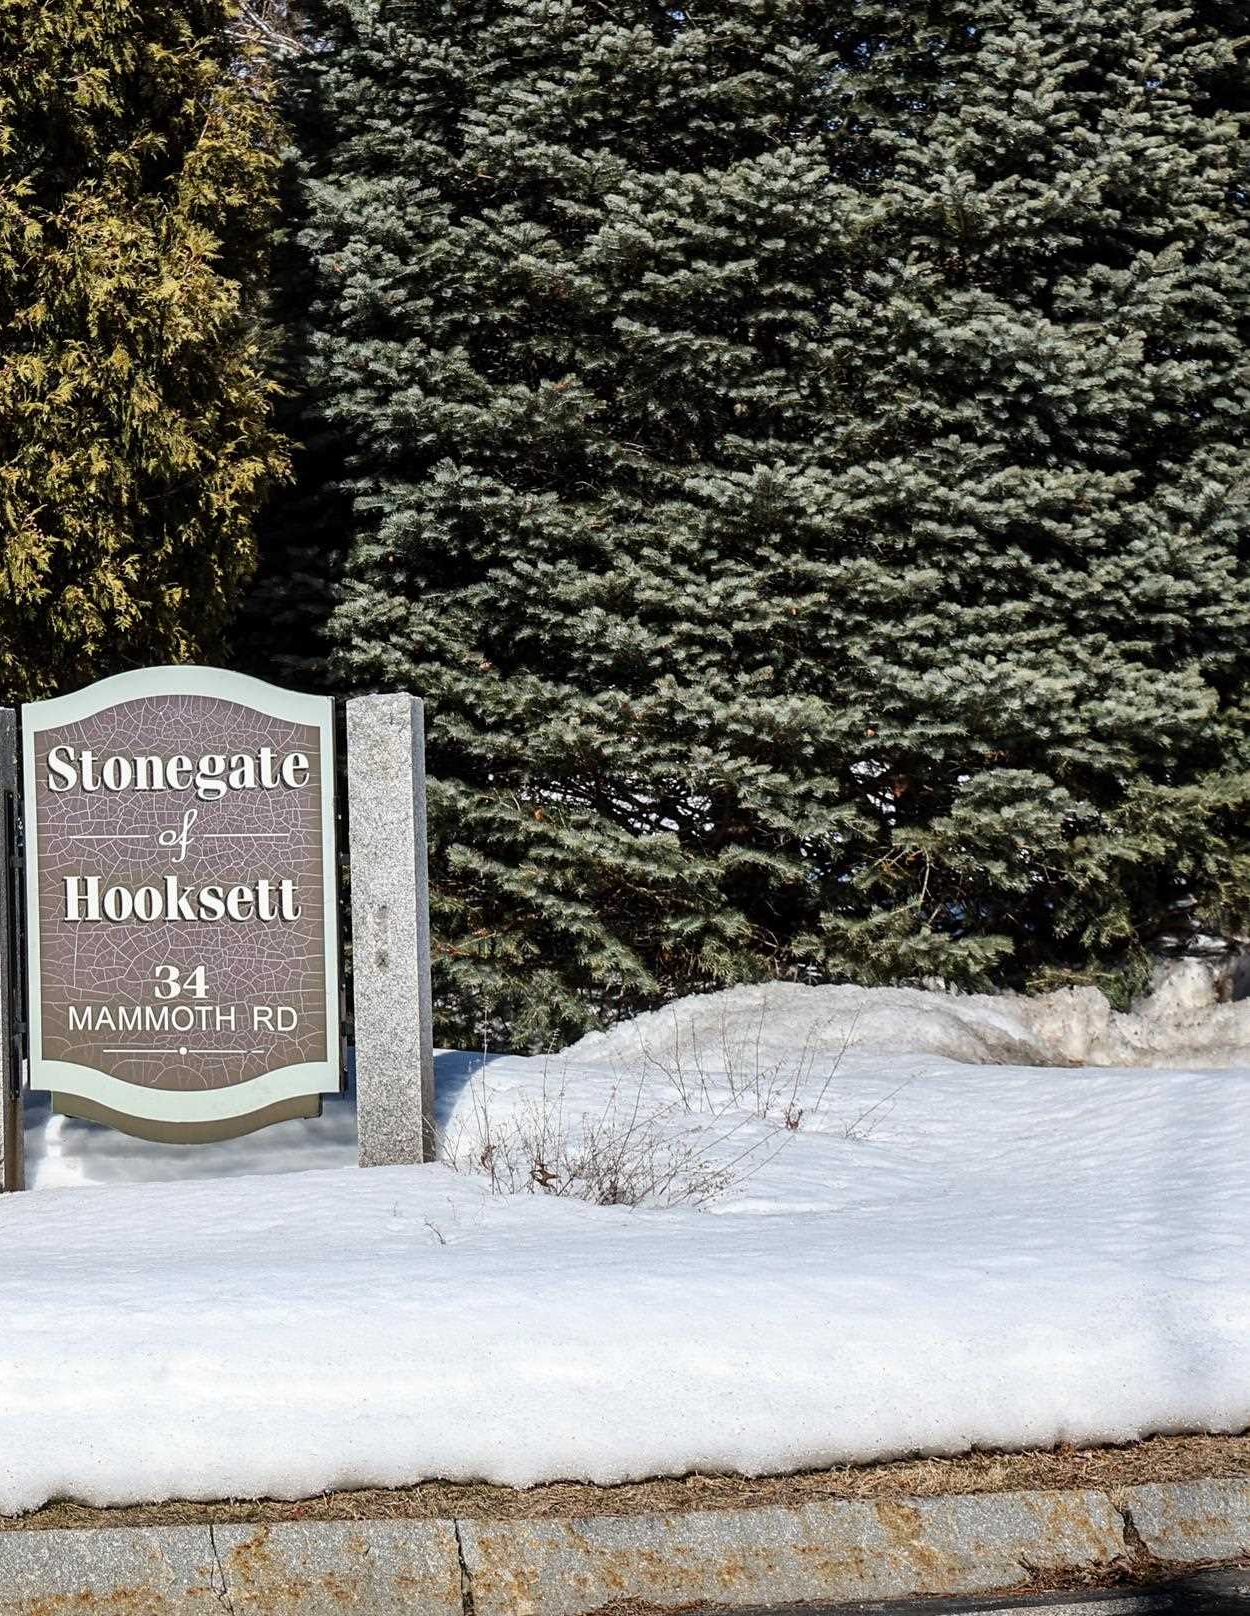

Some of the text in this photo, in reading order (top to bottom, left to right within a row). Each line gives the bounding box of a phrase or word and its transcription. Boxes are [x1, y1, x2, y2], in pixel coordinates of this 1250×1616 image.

[47, 745, 310, 801] Stonegate
[158, 808, 199, 863] of
[62, 875, 302, 923] Hooksett
[154, 965, 210, 999] 34
[68, 1006, 298, 1032] MAMMOTH RD
